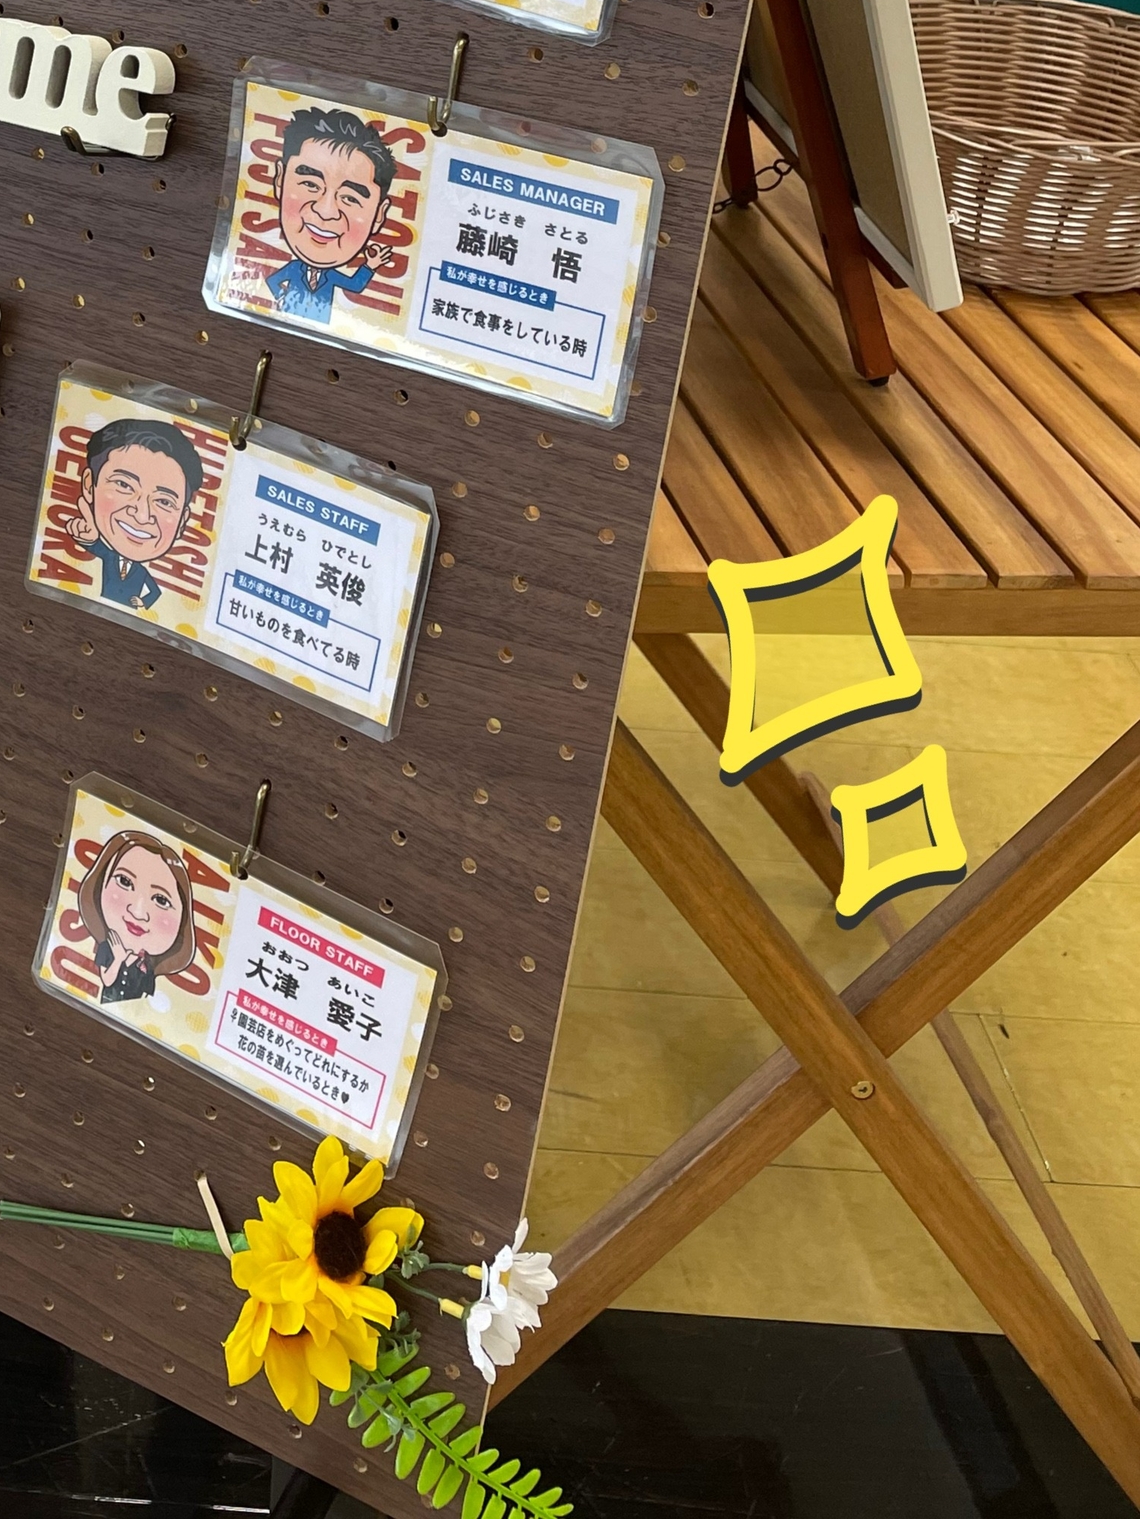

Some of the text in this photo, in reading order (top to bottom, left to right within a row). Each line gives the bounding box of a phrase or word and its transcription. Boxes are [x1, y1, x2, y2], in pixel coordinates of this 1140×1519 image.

[460, 166, 606, 217] SALES MANAGER
[455, 222, 582, 284] 藤崎 悟
[468, 202, 589, 245] ふじさき さとる
[446, 266, 549, 305] 私が幸せを感じるとき
[430, 298, 588, 359] 家族で食事をしている時
[267, 484, 370, 536] SALES STAFF
[244, 534, 366, 607] 上村 英俊
[258, 512, 373, 570] うえむら ひでとし
[238, 574, 325, 622] 私が幸せを感じるとき
[229, 598, 361, 671] 甘いものを食べてる時
[261, 940, 378, 1008] おおつ あいこ
[269, 916, 374, 977] FLOOR STAFF
[243, 995, 328, 1048] 私が幸せを感じるとき
[245, 957, 383, 1043] 大津 愛子
[238, 1012, 369, 1093] 園芸店をめぐってどれにするか
